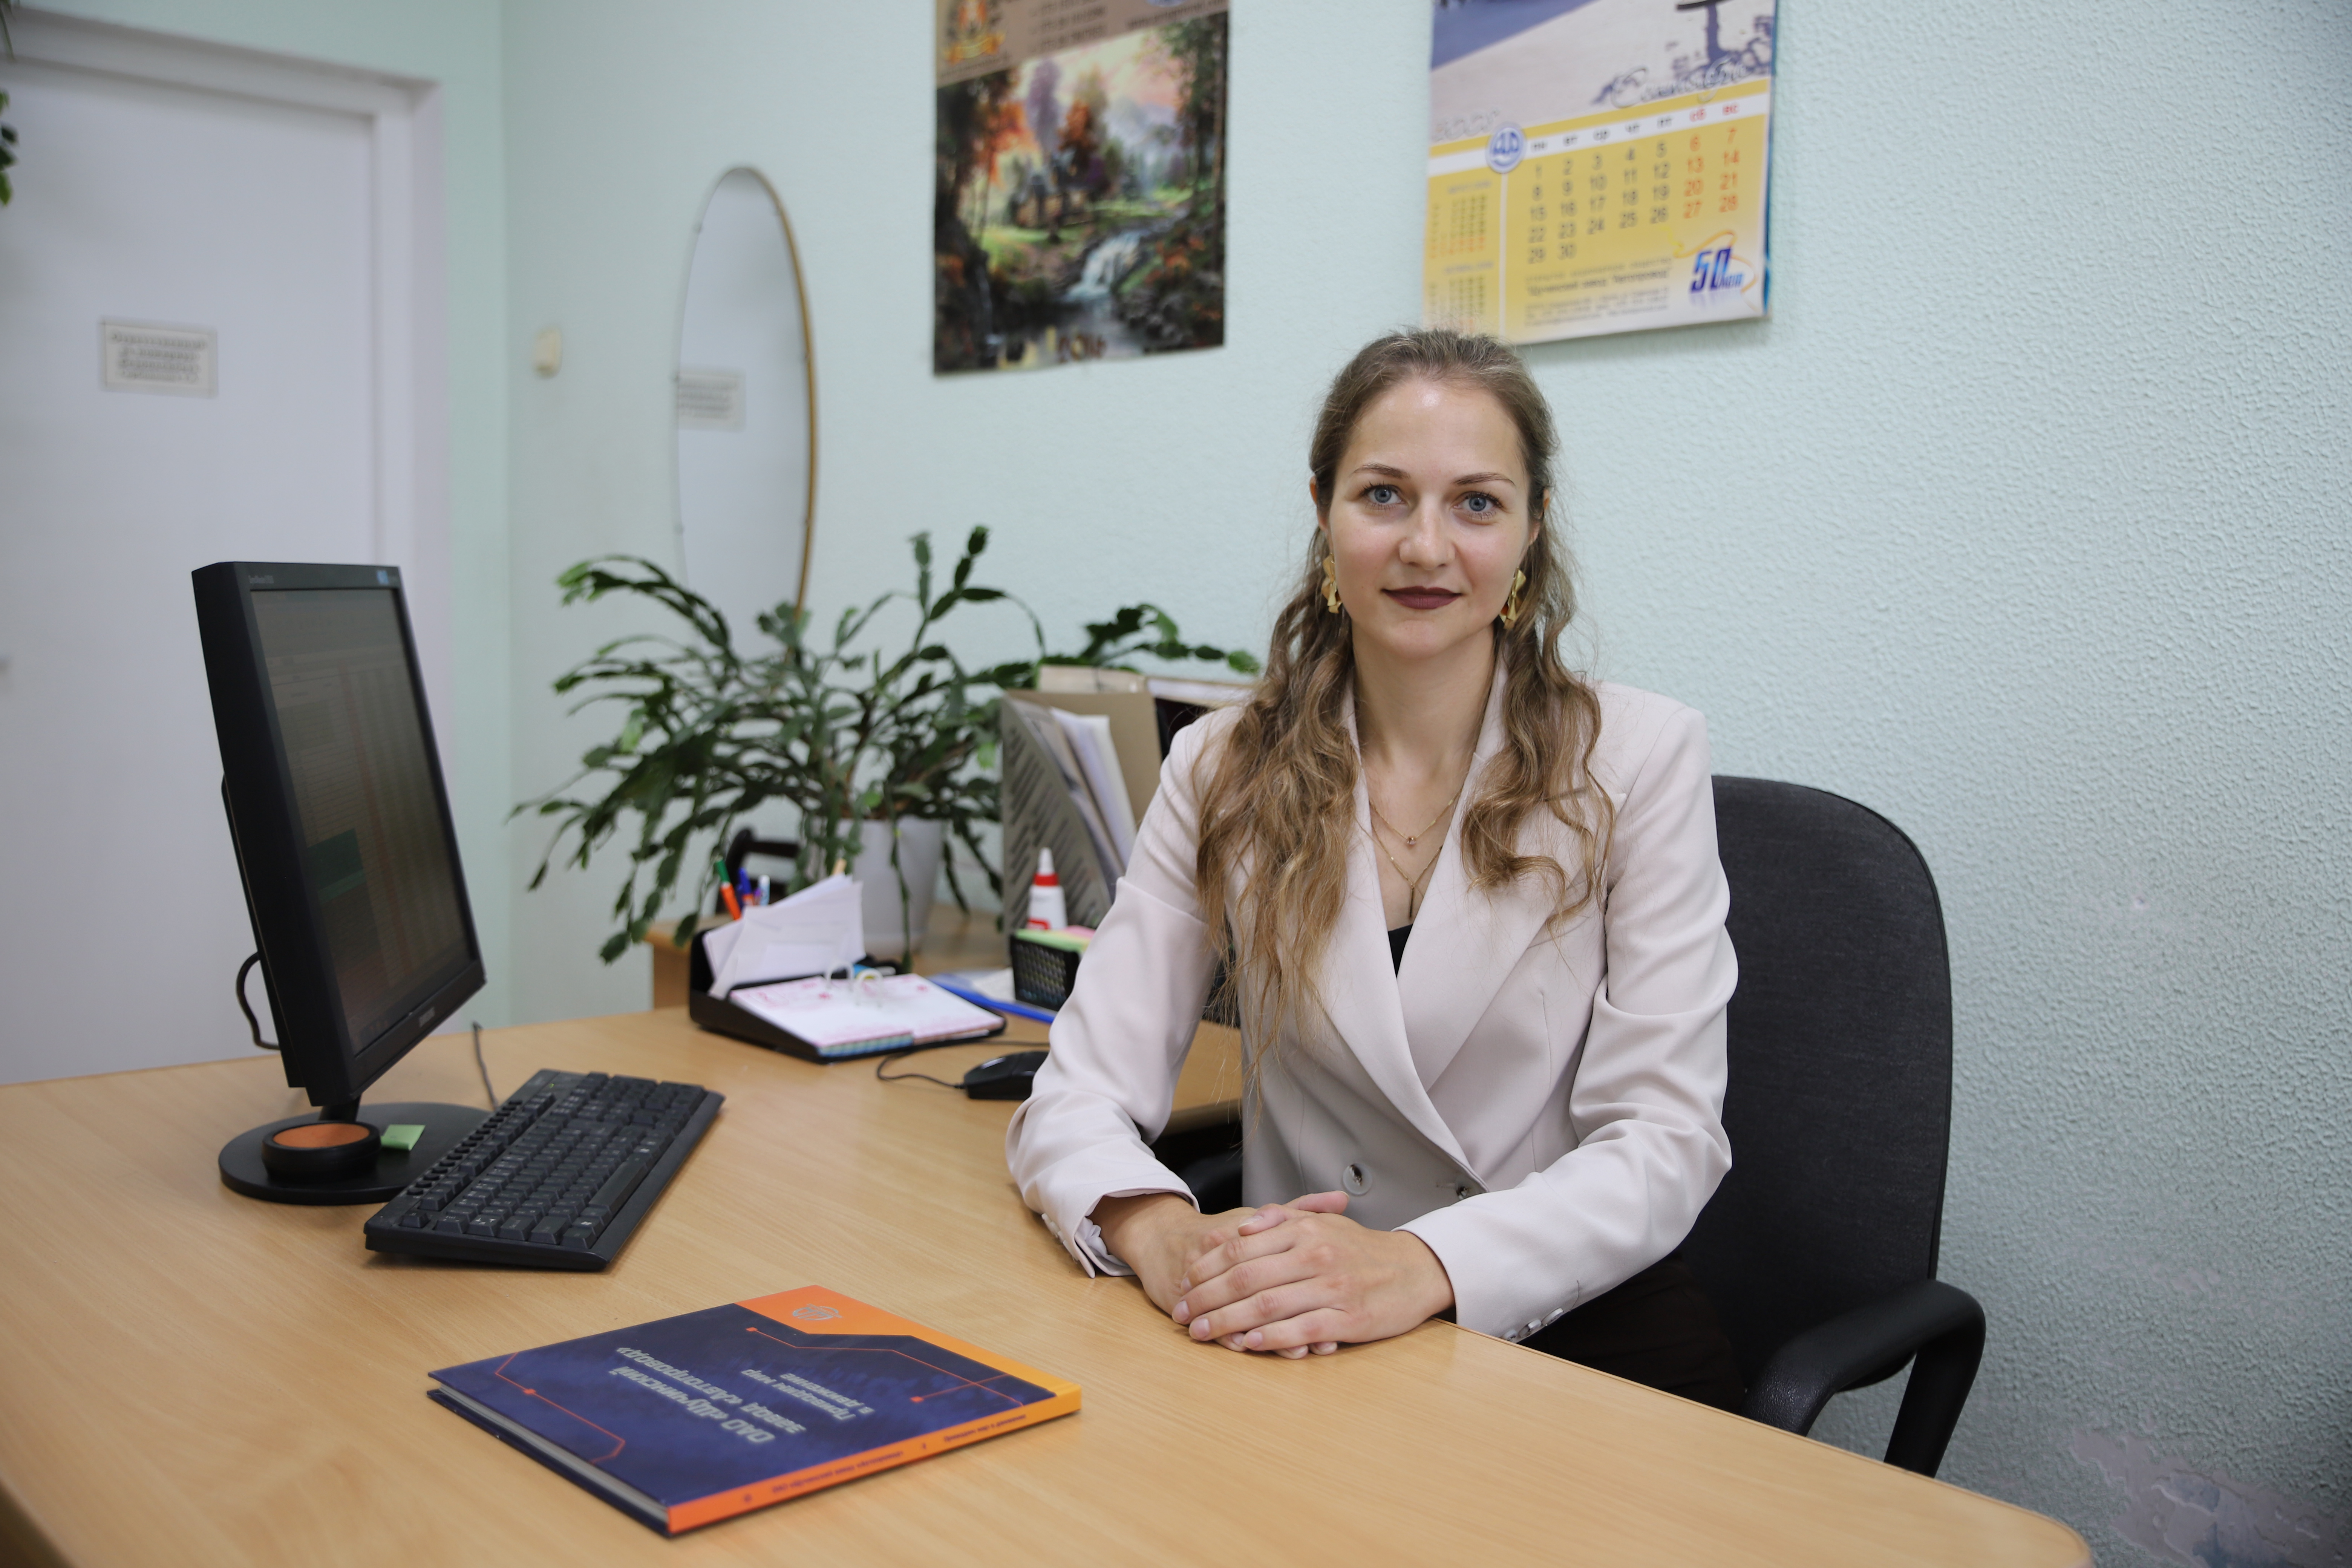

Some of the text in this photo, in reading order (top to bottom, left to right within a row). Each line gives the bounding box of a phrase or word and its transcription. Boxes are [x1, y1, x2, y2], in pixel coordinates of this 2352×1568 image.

[1531, 150, 1740, 201] 8 9 10 11 12 13 14
[1536, 127, 1737, 179] 1 2 3 4 5 6 7
[1528, 193, 1739, 243] 22 23 24 25 26 27 28
[1530, 172, 1738, 222] 15 16 17 18 19 20 21
[1528, 241, 1577, 264] 29 30
[1690, 248, 1731, 293] 50
[608, 1366, 776, 1443] ОАО «Щучинский
[616, 1347, 807, 1433] завод «Автопровод»
[741, 1369, 856, 1421] Приводим мир
[780, 1373, 875, 1415] в движение
